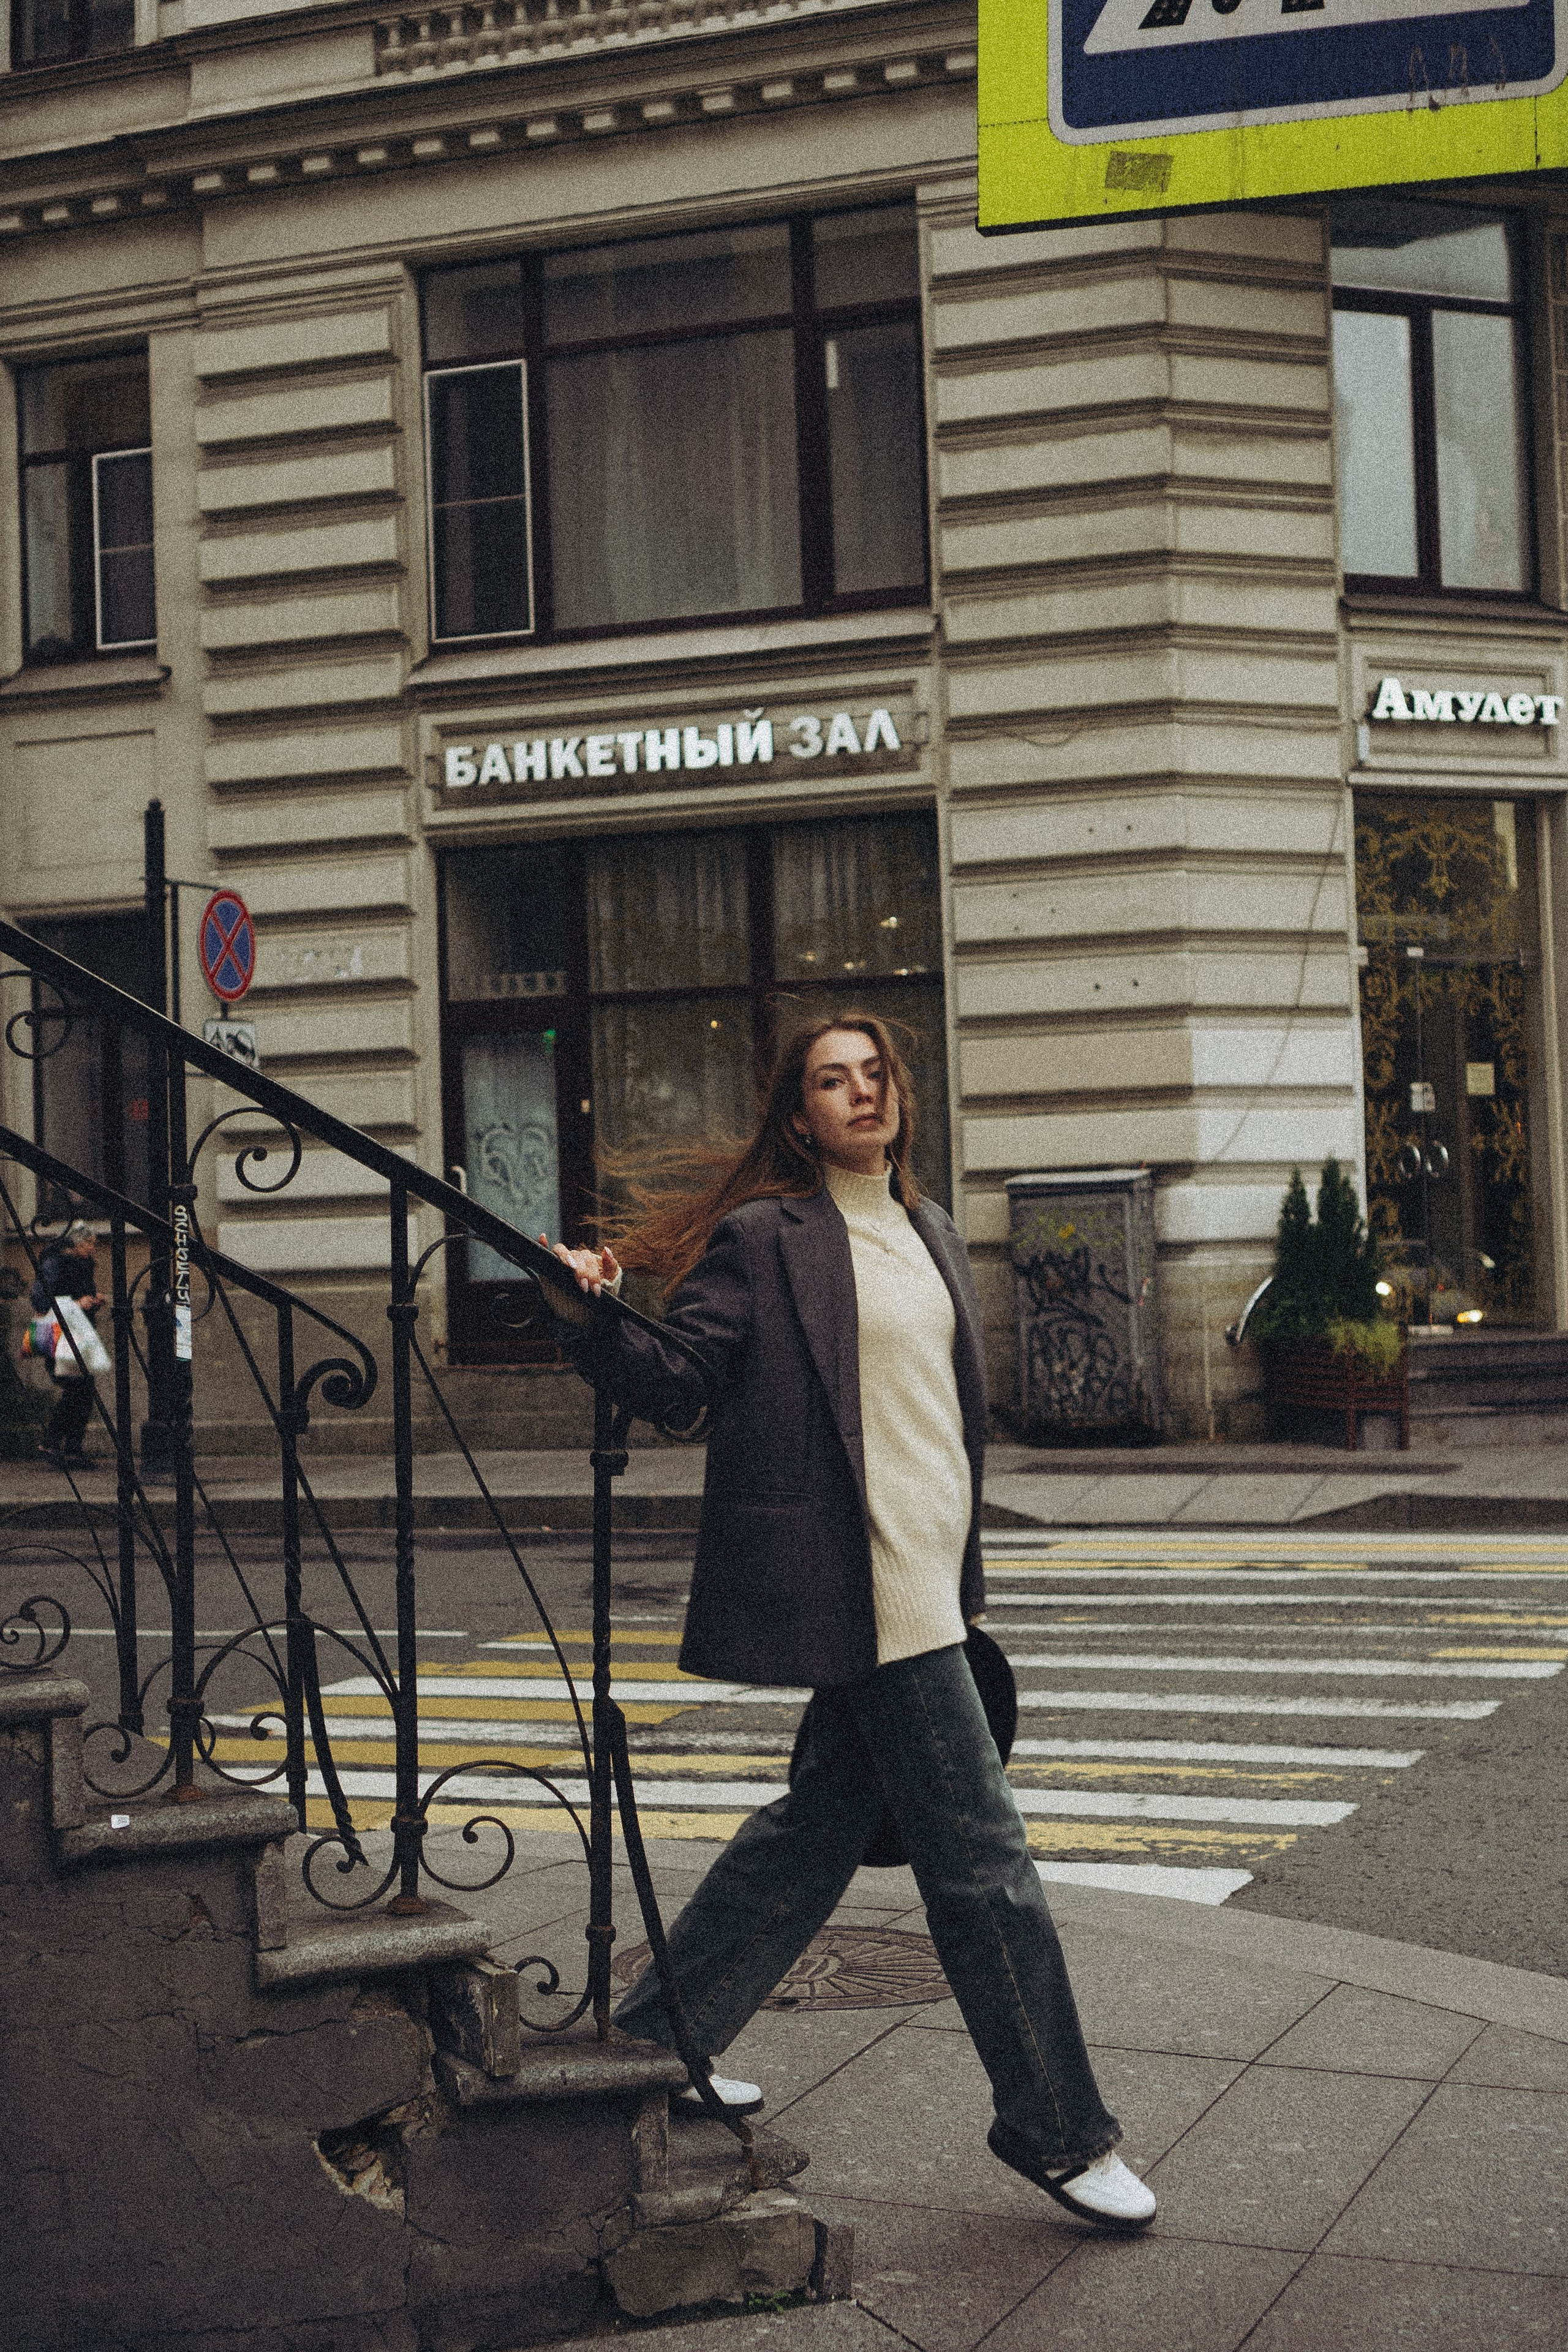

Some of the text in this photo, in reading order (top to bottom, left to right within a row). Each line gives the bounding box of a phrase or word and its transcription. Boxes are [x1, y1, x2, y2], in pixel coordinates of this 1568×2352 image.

[1372, 677, 1562, 726] Амулет
[444, 707, 902, 788] БАНКЕТНЫЙ ЗАЛ
